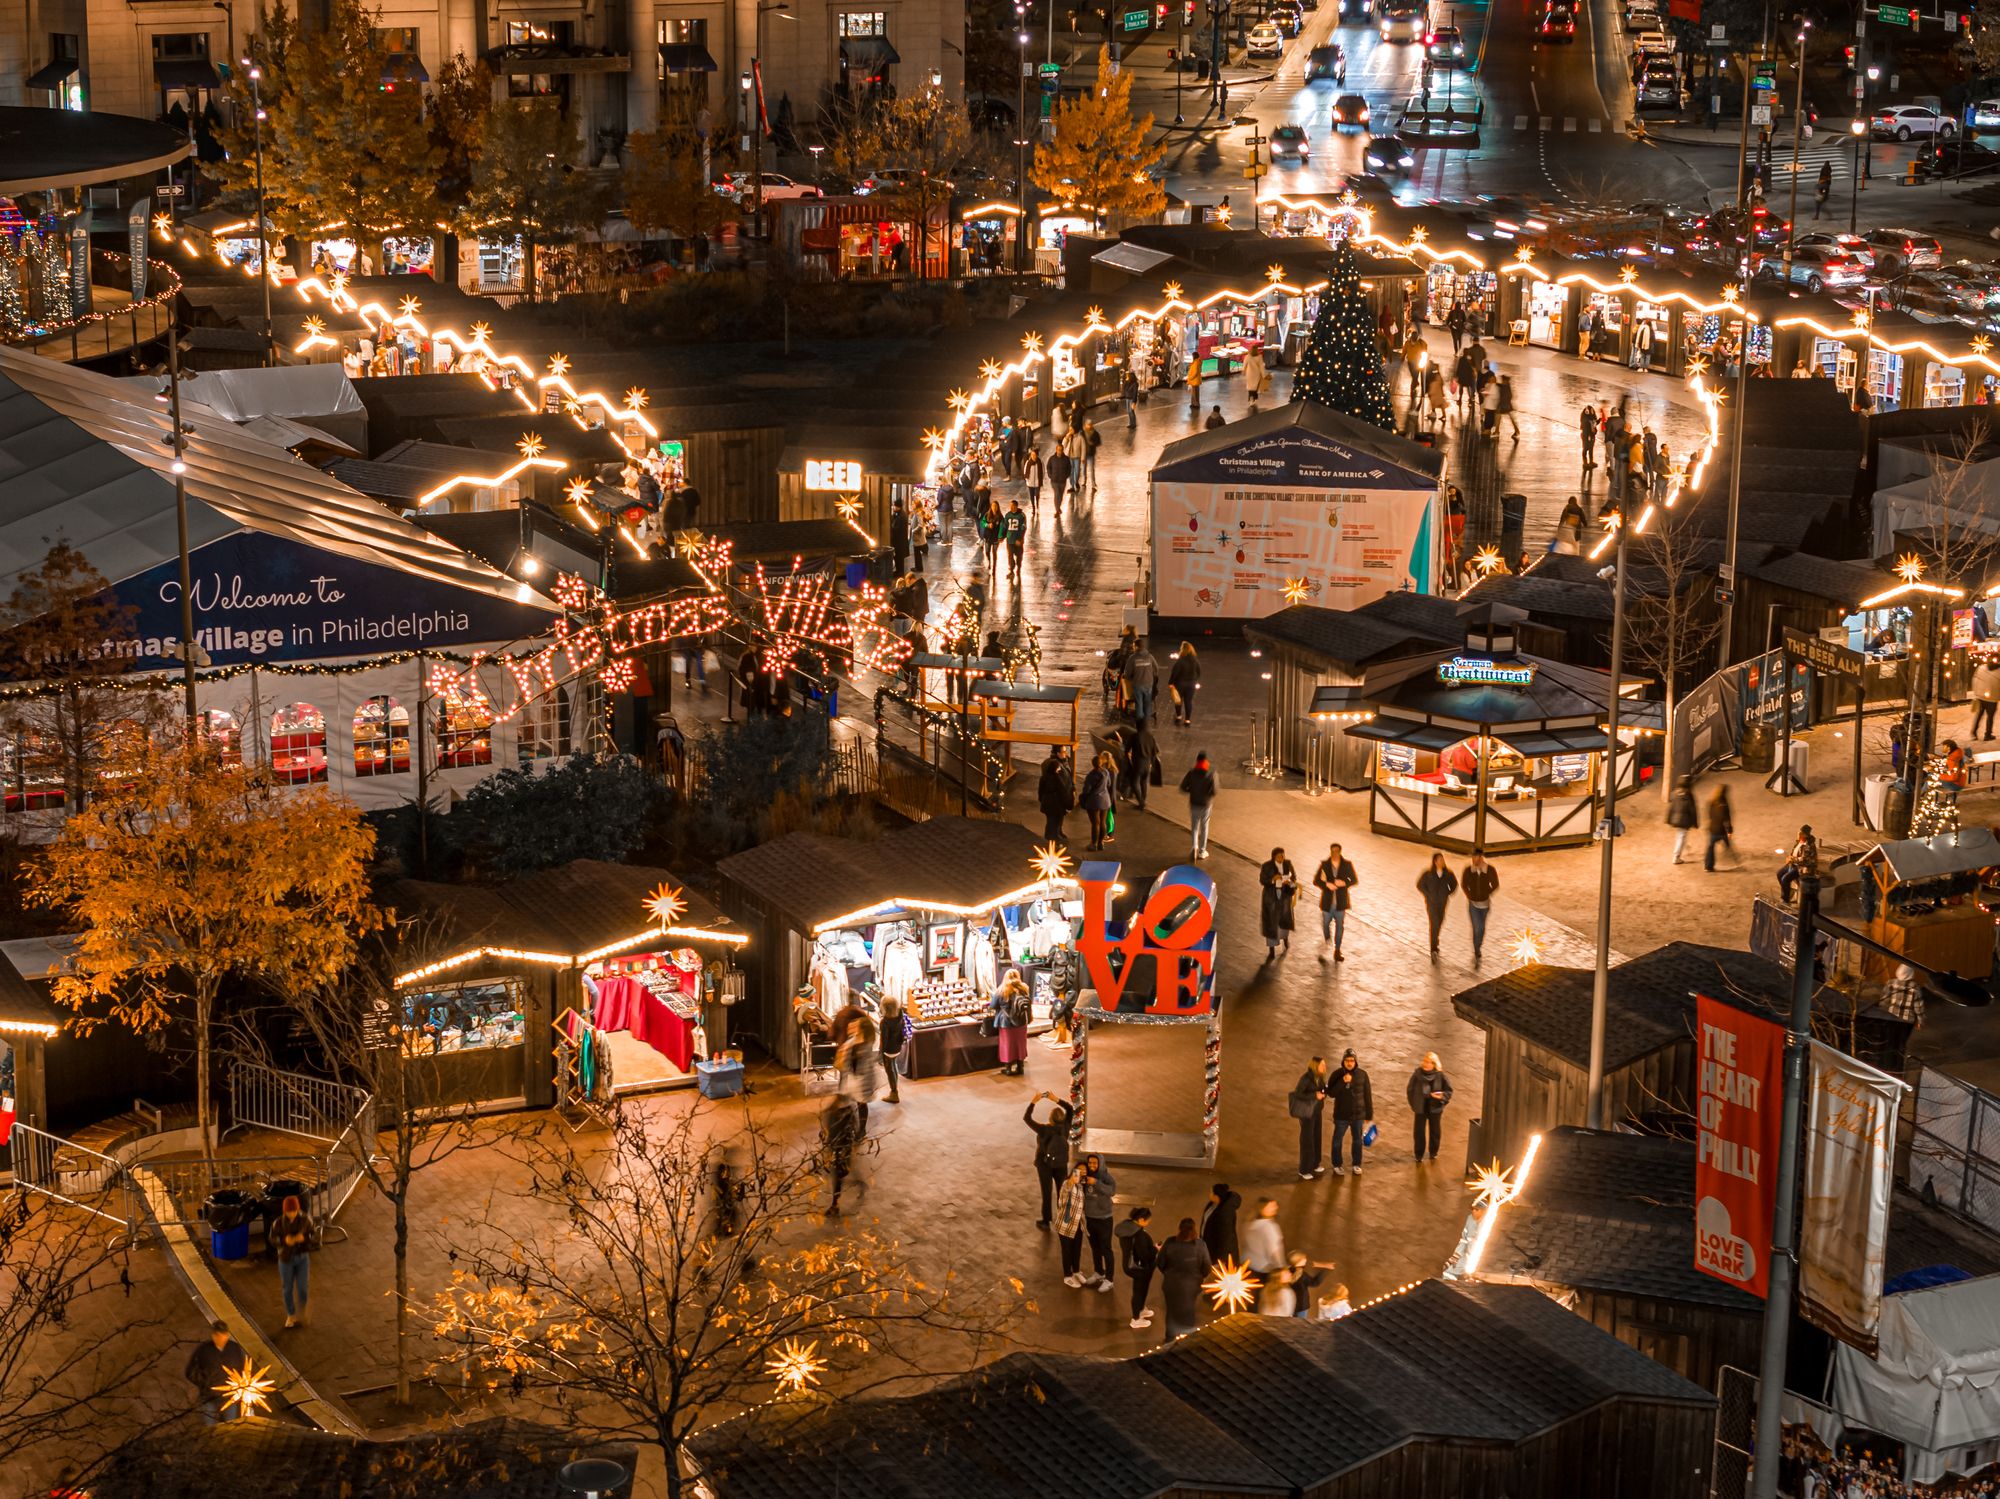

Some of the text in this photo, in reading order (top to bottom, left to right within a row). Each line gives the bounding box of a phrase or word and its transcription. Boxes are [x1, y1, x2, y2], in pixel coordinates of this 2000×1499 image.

[805, 459, 862, 491] BEER
[1219, 457, 1286, 468] Christmas Village
[1236, 467, 1277, 476] Philadelphia
[1298, 469, 1320, 477] BANK
[1333, 470, 1368, 478] AMERICA
[1007, 518, 1019, 531] 12
[159, 572, 346, 612] Welcome to
[762, 571, 830, 586] NFORMATION
[189, 625, 284, 654] Village
[291, 622, 313, 647] in
[322, 609, 469, 642] Philadelphia
[756, 553, 915, 682] Village
[1452, 656, 1493, 669] German
[1786, 637, 1861, 676] THE BEER ALM
[1439, 664, 1531, 684] Bratwurst
[1702, 1022, 1737, 1068] THE
[1700, 1059, 1761, 1113] HEART
[1699, 1095, 1724, 1134] OF
[1699, 1130, 1761, 1185] PHILLY
[1700, 1228, 1745, 1260] LOVE
[1699, 1246, 1745, 1277] PARK
